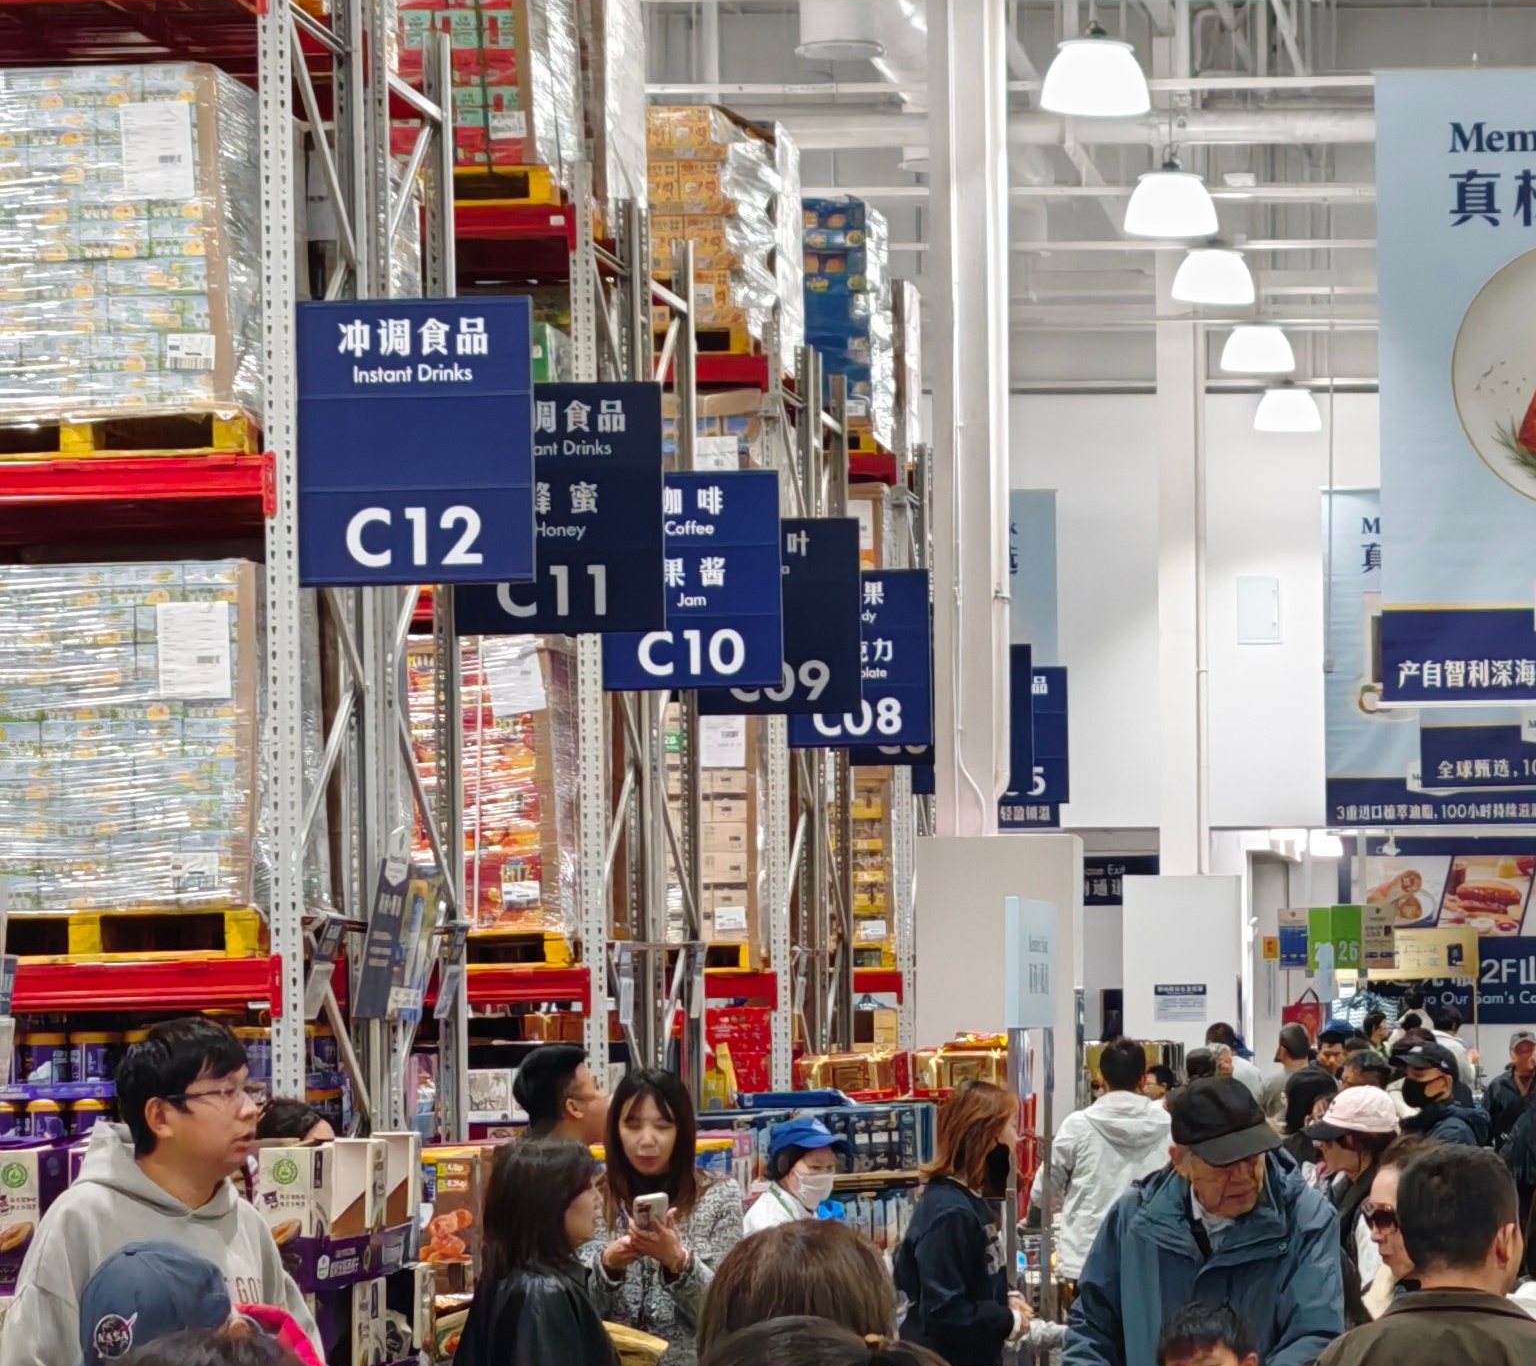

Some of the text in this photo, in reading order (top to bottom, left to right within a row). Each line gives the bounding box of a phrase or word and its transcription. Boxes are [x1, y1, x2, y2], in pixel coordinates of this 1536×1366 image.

[337, 317, 489, 358] 冲调食品
[353, 362, 473, 384] Instant Drinks
[534, 399, 627, 433] 调食品
[563, 439, 612, 456] Drinks
[664, 486, 723, 515] 咖啡
[345, 505, 484, 568] C12
[536, 521, 587, 542] Honey
[664, 520, 715, 536] Coffee
[787, 530, 810, 557] 叶
[664, 557, 726, 587] 果酱
[497, 565, 607, 618] C11
[676, 592, 707, 608] Jam
[863, 581, 885, 605] 果
[637, 628, 746, 676] C10
[1440, 991, 1469, 1005] Our
